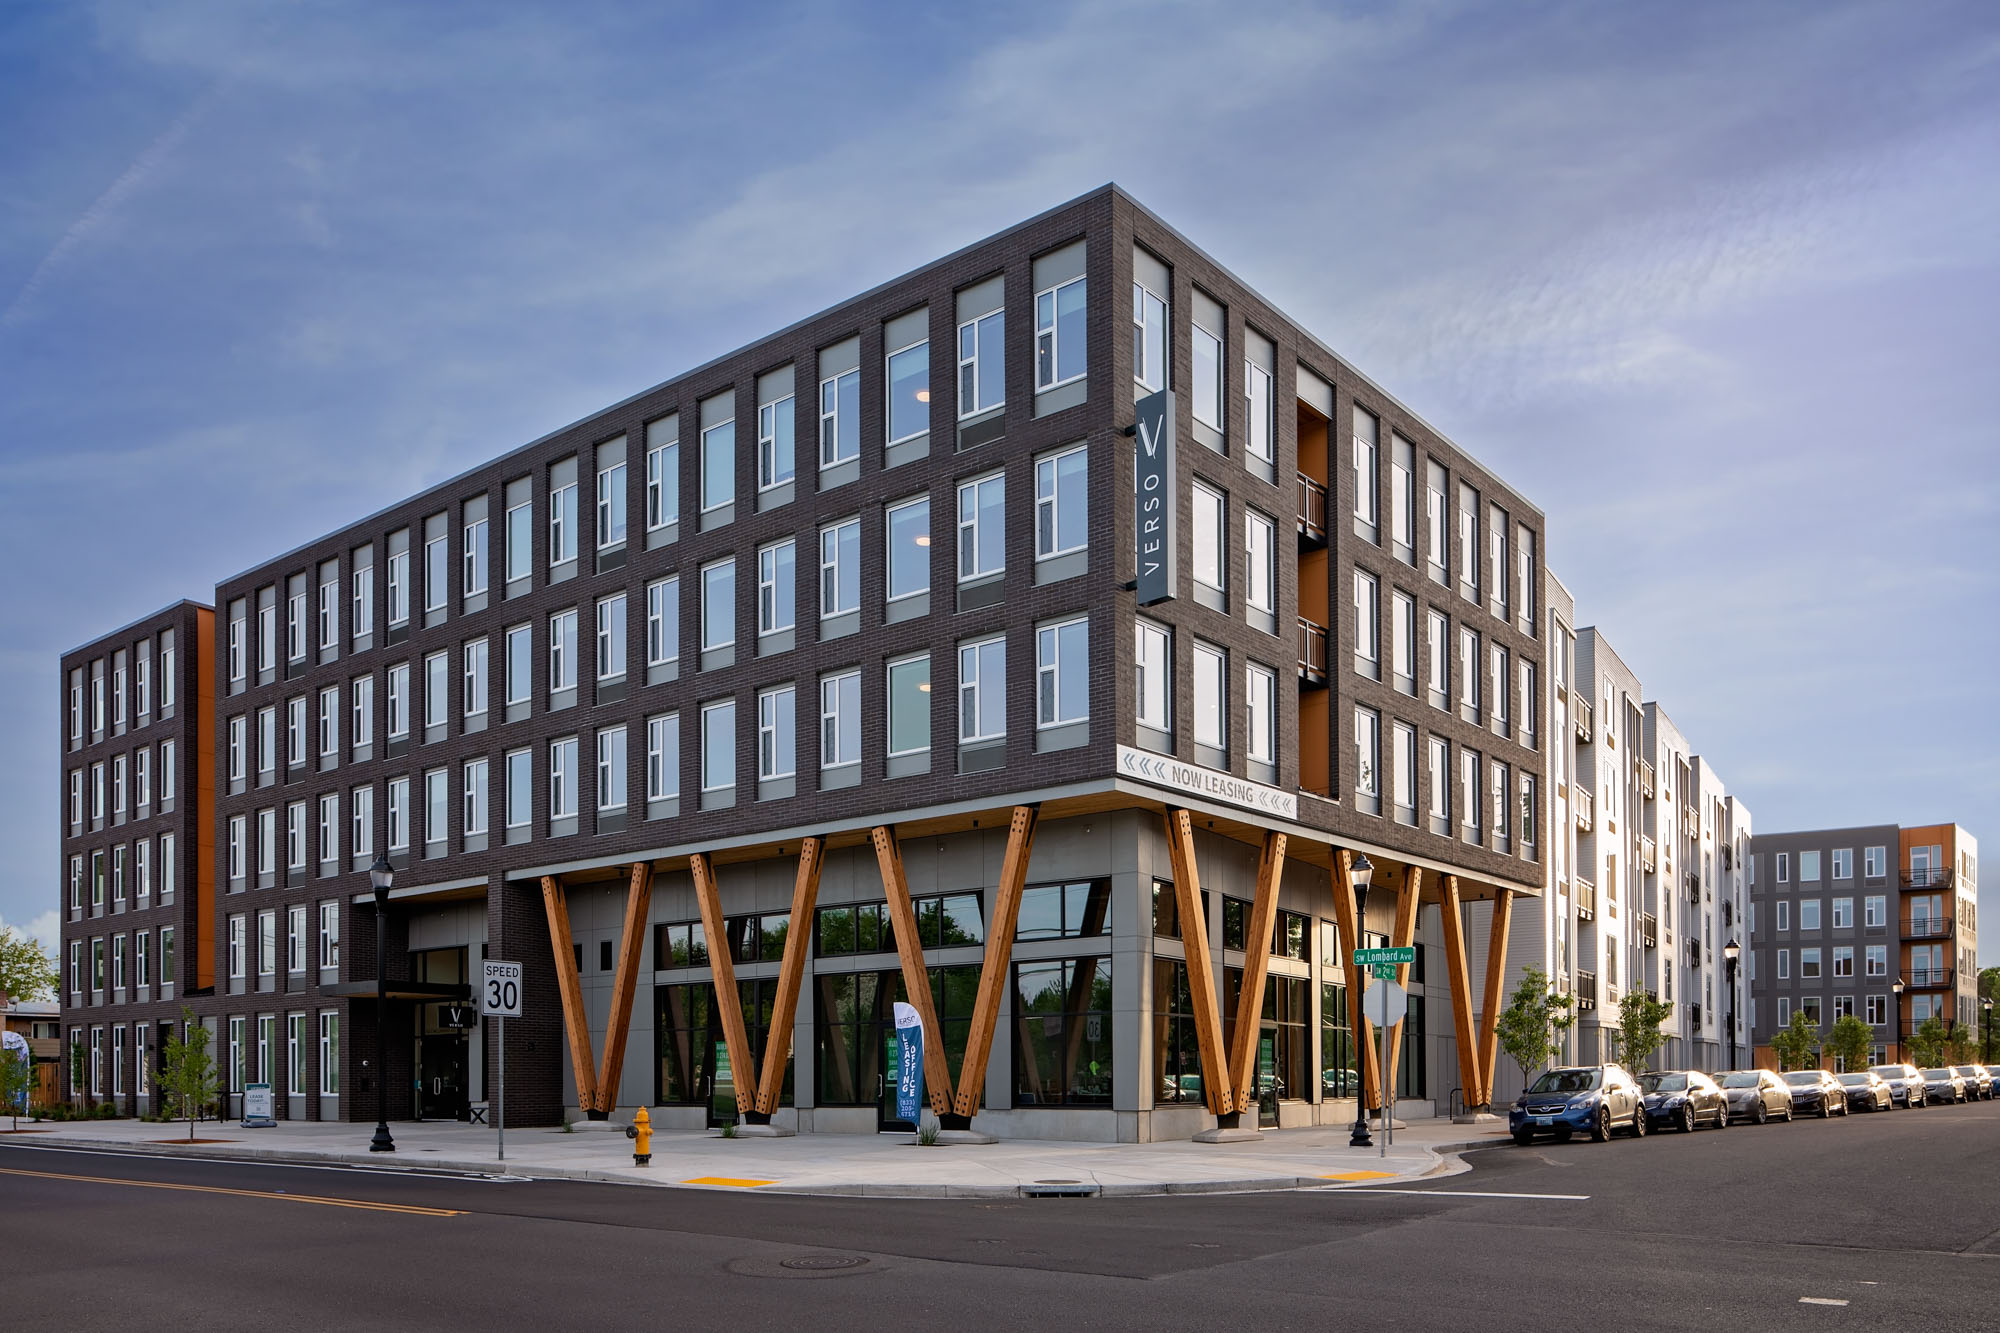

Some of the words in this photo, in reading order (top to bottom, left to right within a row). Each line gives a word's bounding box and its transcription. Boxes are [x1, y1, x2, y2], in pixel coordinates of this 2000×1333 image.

[1143, 473, 1161, 577] VERSO
[1172, 765, 1202, 789] NOW
[1205, 774, 1254, 803] LEASING
[486, 965, 519, 978] SPEED
[1355, 954, 1365, 963] SW
[1367, 951, 1398, 962] Lombard
[1400, 952, 1412, 961] Ave
[487, 979, 518, 1011] 30
[902, 1033, 910, 1093] LEASING
